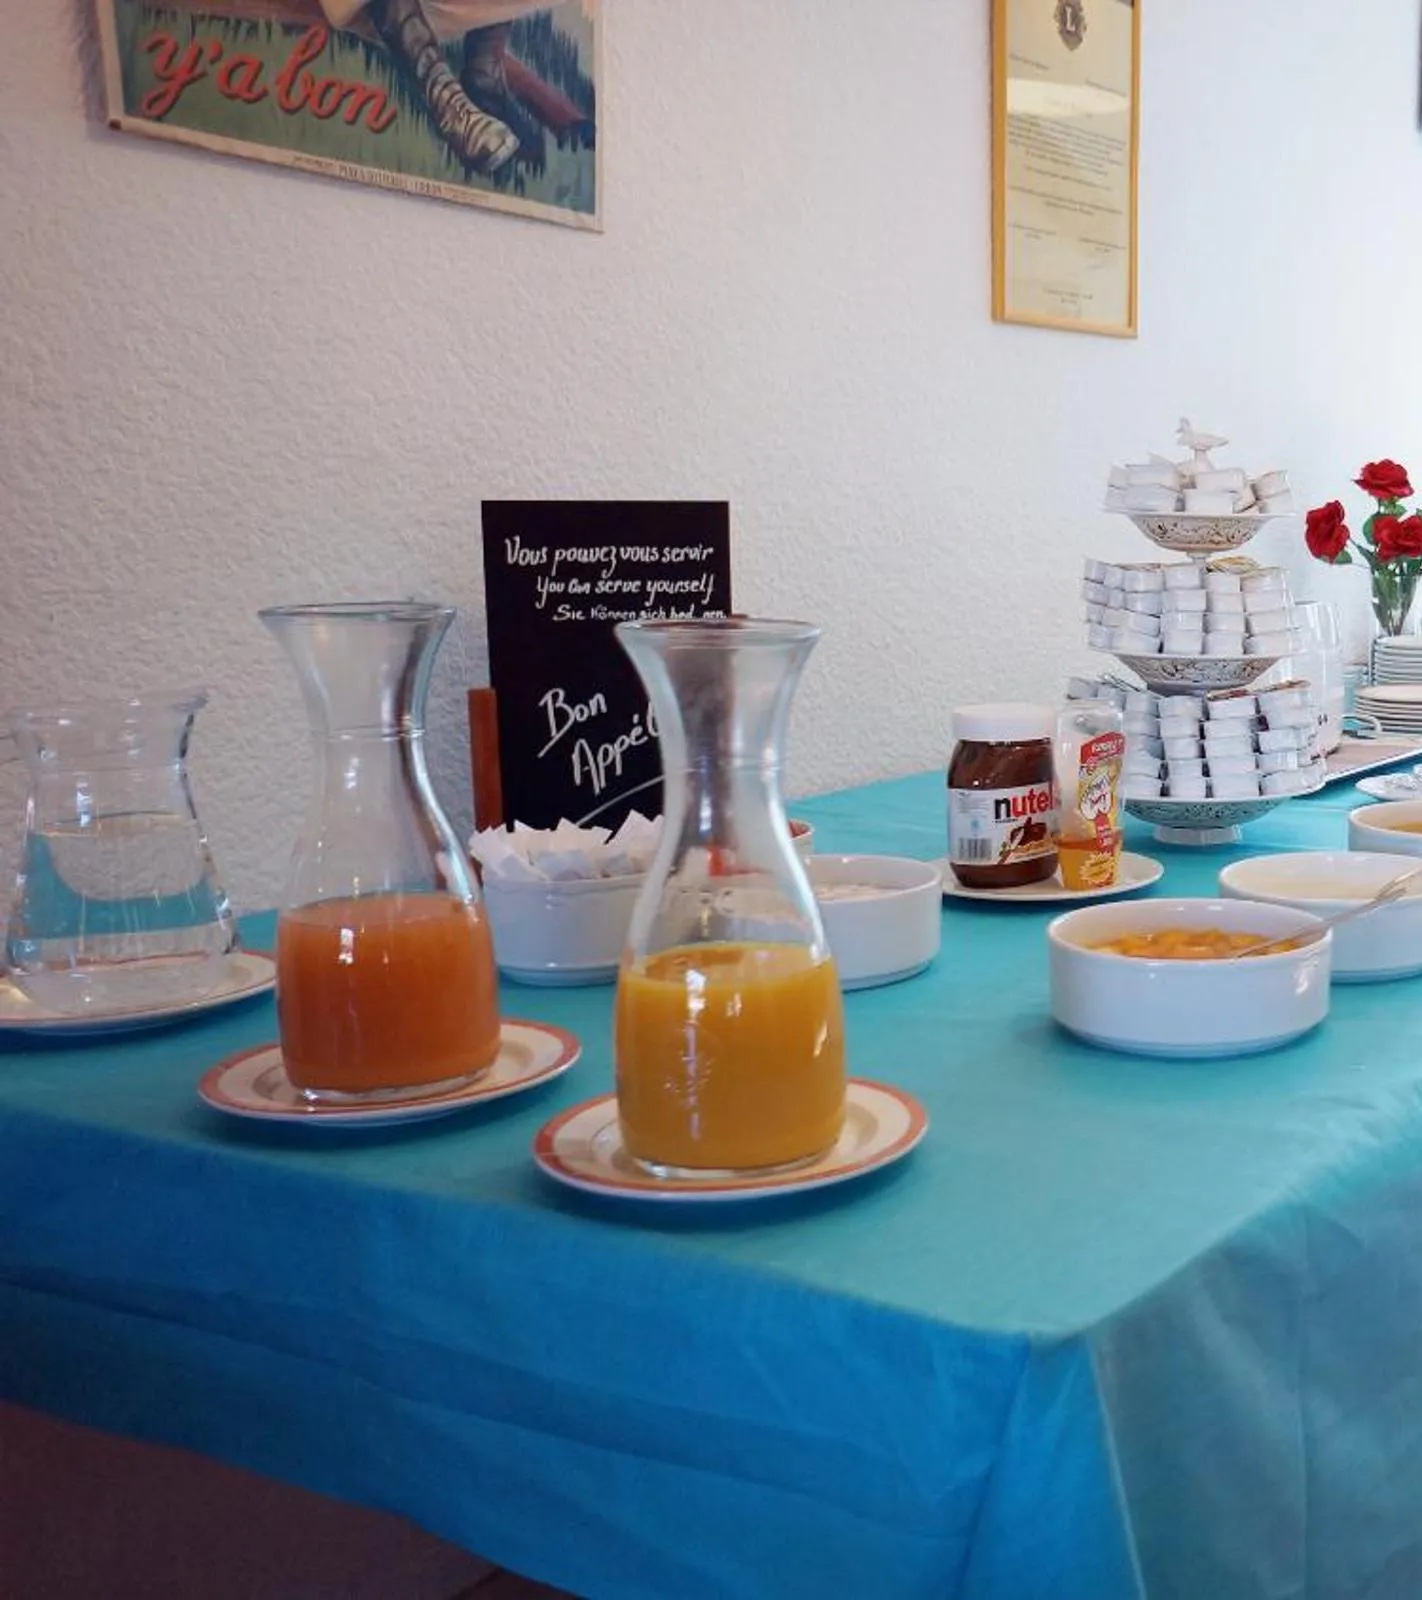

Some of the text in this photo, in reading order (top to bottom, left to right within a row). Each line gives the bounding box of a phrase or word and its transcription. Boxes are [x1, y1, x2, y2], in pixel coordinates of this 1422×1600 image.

[276, 22, 398, 134] bon
[505, 535, 714, 578] Vous pouvez vous servir
[535, 574, 566, 609] You
[595, 579, 641, 594] serve
[645, 573, 714, 606] yourself
[552, 604, 586, 621] Sie
[537, 687, 607, 758] Bon
